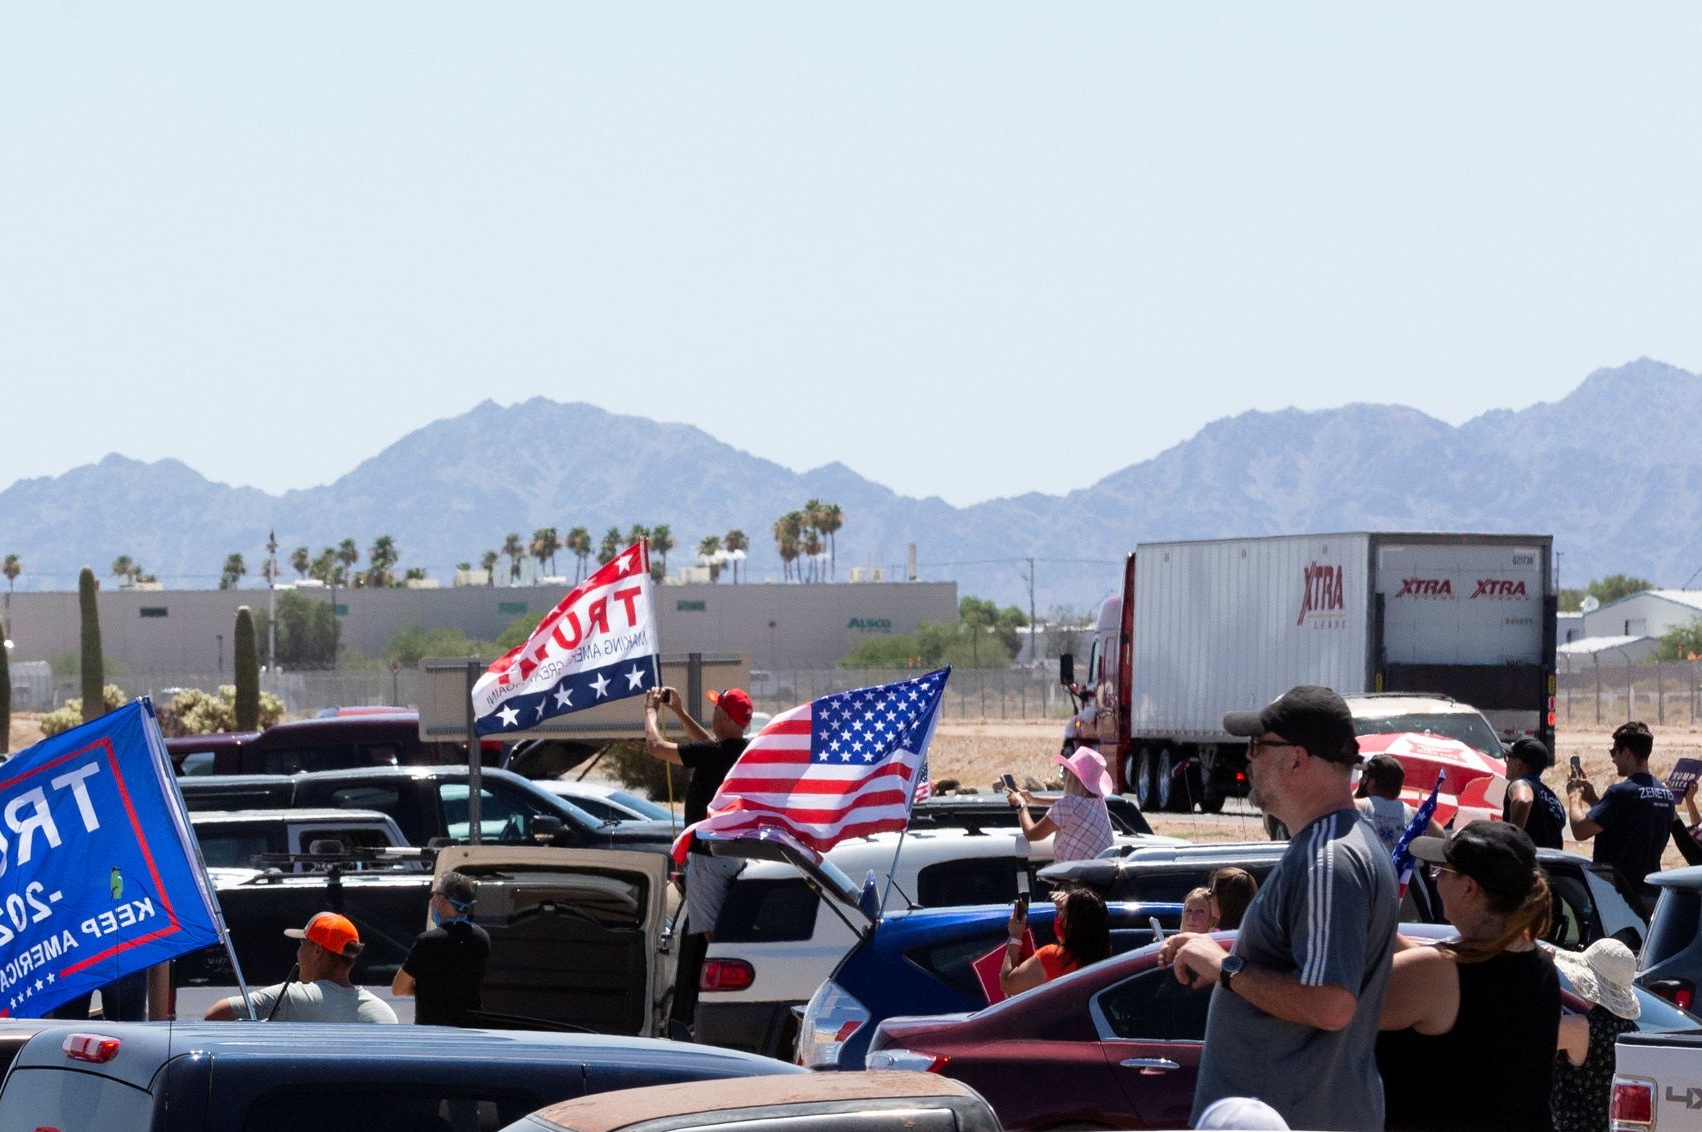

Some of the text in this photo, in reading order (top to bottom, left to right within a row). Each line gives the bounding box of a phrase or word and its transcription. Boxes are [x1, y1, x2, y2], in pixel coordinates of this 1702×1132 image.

[1297, 561, 1344, 626] XTRA
[1395, 577, 1452, 599] XTRA
[1470, 578, 1527, 600] XTRA
